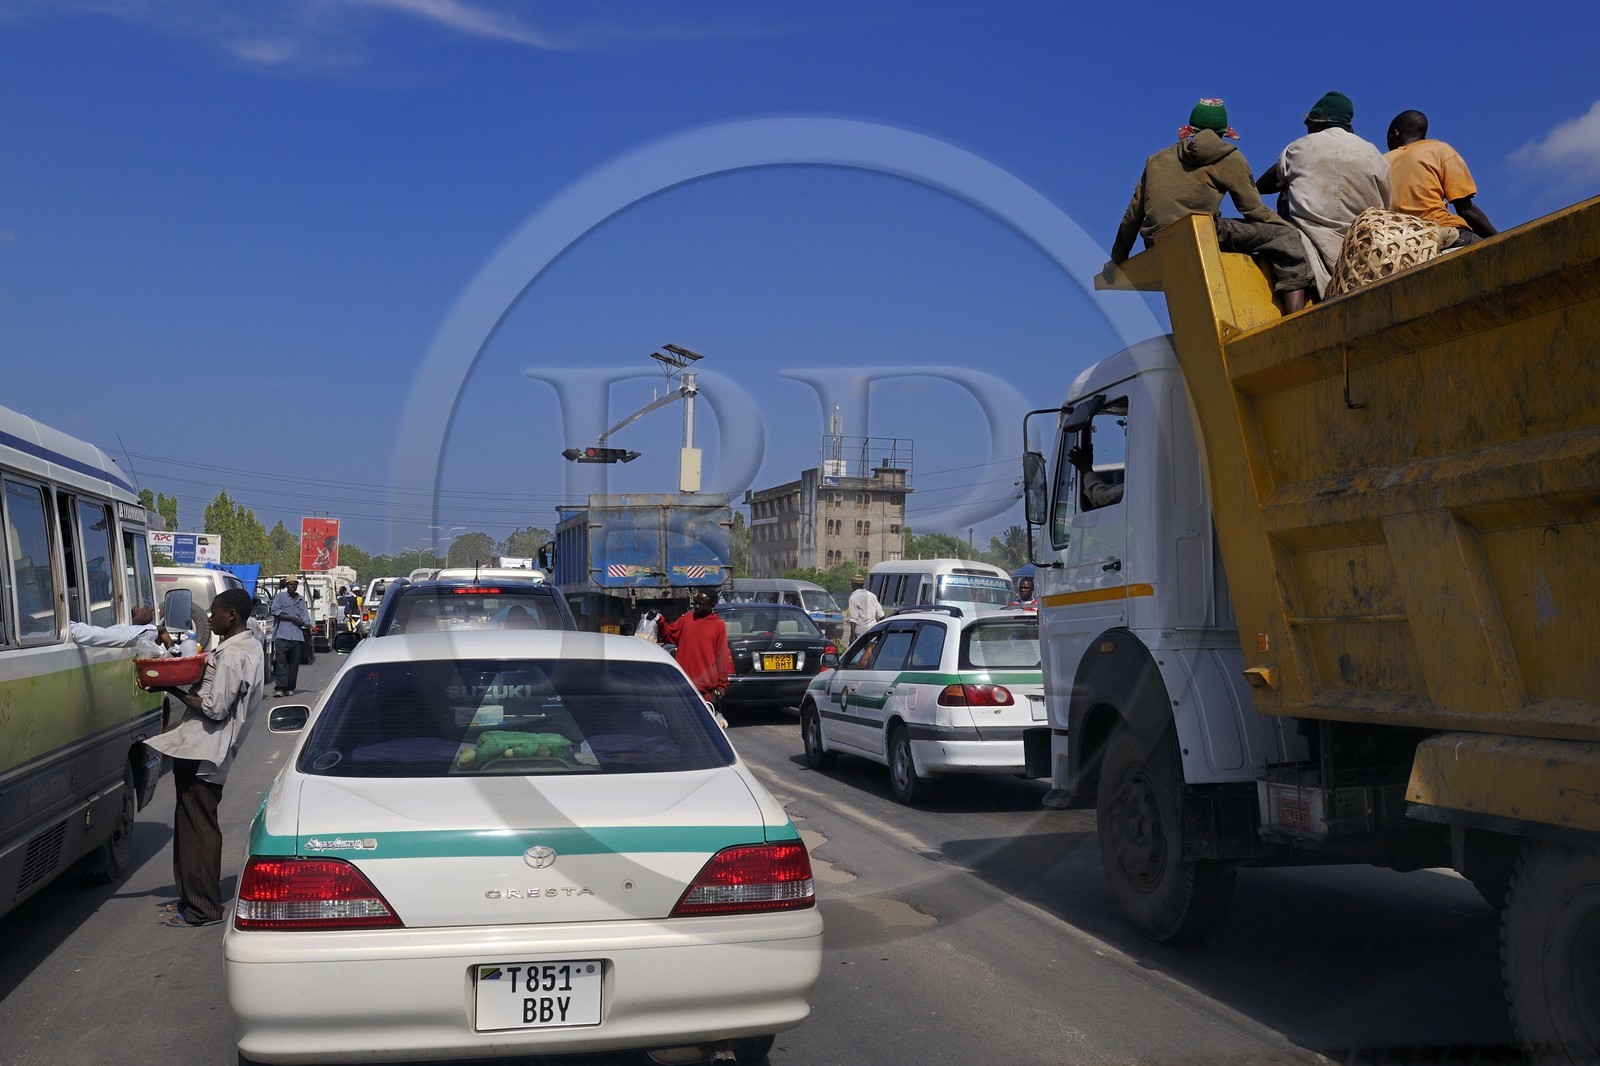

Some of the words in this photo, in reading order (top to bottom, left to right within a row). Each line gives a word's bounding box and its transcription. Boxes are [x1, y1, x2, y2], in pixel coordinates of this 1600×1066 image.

[445, 684, 532, 699] SUZUKI
[484, 887, 595, 900] CRESTA
[523, 996, 571, 1023] BBY
